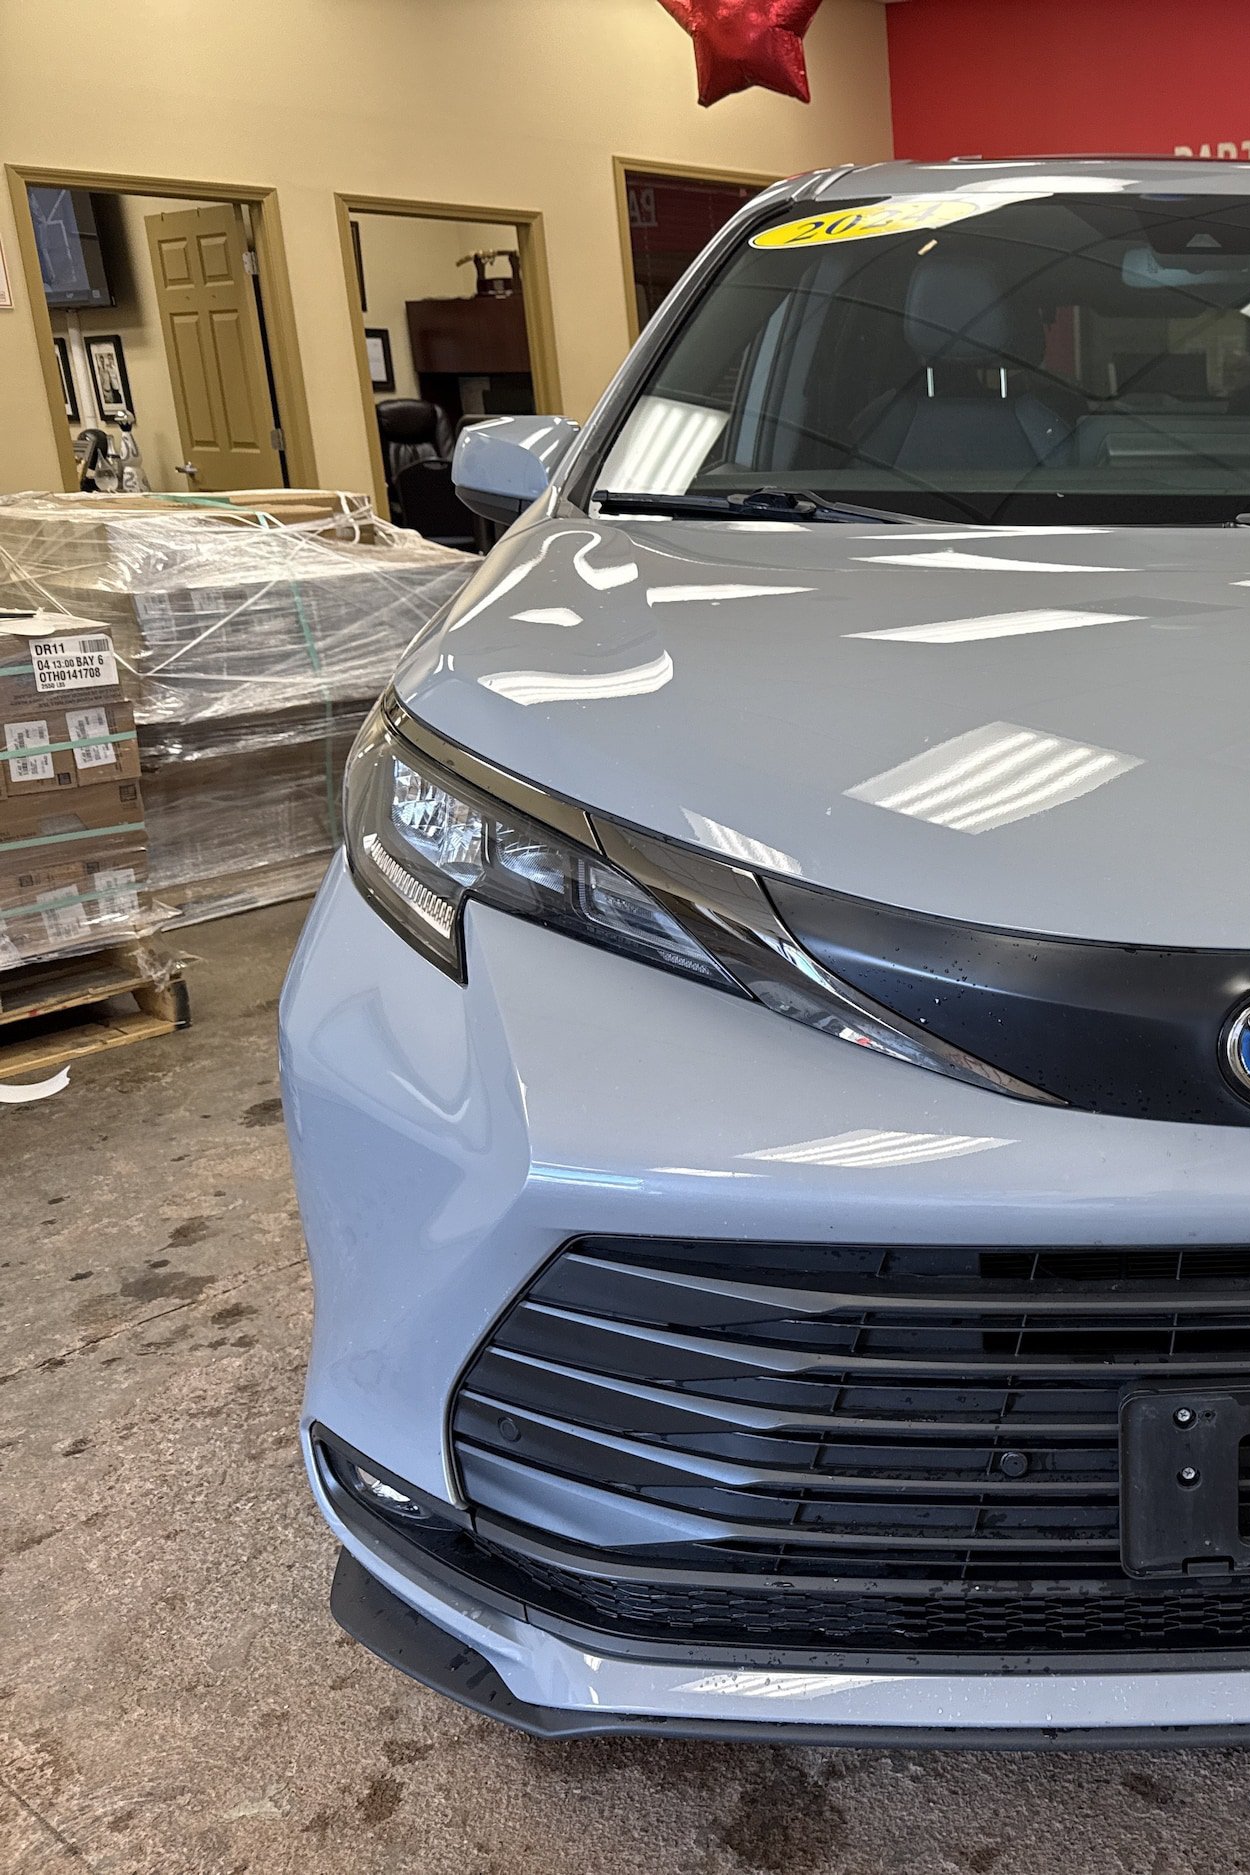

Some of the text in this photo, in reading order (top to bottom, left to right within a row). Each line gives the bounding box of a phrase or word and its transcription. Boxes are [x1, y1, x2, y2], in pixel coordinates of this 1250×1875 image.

[784, 201, 943, 244] 2024
[34, 643, 65, 656] DR11
[37, 654, 104, 671] 04 13:00 BAY 6
